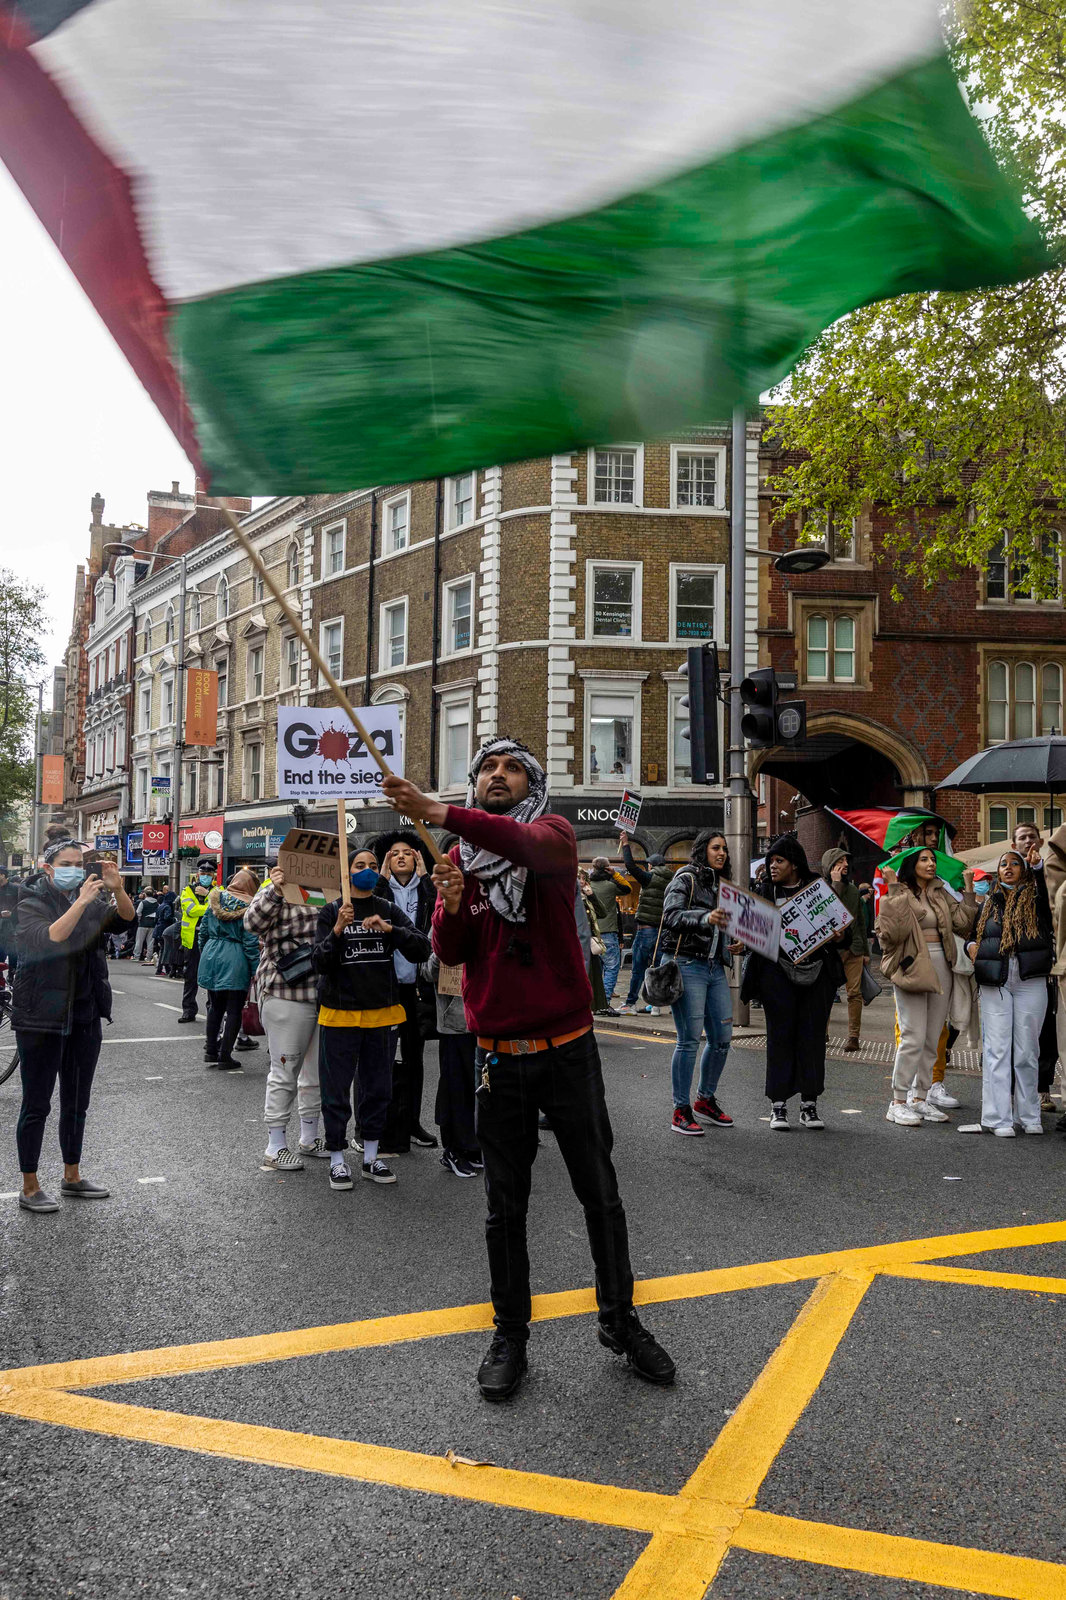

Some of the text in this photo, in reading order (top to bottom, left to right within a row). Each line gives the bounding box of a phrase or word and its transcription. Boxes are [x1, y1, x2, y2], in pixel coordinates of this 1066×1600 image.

[194, 671, 203, 718] FOR CULTURE
[284, 769, 385, 787] End the sieg
[577, 809, 619, 821] KNOO
[620, 803, 639, 821] FREE
[346, 819, 354, 829] K
[183, 830, 206, 844] brompto
[286, 853, 336, 879] Palestine
[721, 886, 756, 909] STOP
[794, 882, 821, 905] STAND
[805, 893, 823, 909] WITH
[807, 893, 837, 921] JUSTICE
[780, 905, 800, 930] REE
[787, 917, 839, 960] PALESTINE
[344, 941, 385, 959] فلسطين
